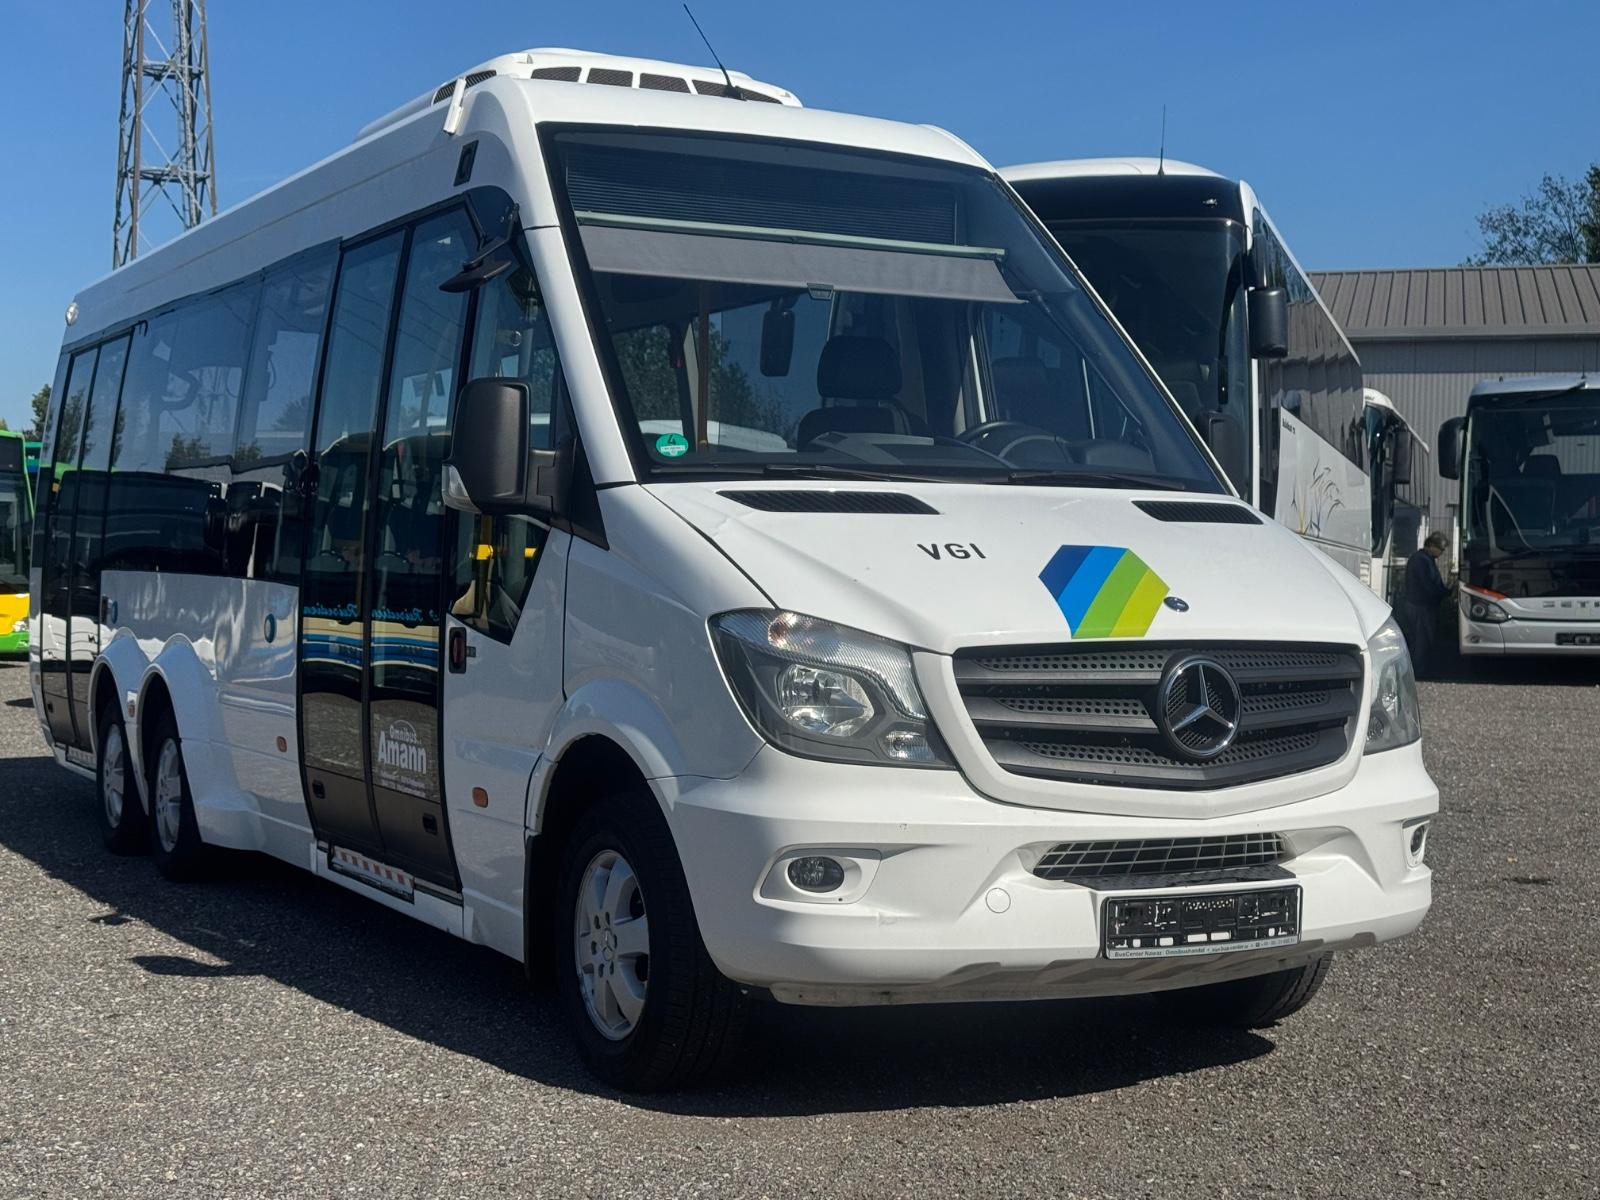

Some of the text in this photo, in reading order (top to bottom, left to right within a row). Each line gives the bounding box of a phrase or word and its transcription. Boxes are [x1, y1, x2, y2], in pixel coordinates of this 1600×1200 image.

[667, 434, 677, 445] 4
[916, 543, 986, 560] VGI
[378, 730, 427, 775] Amann
